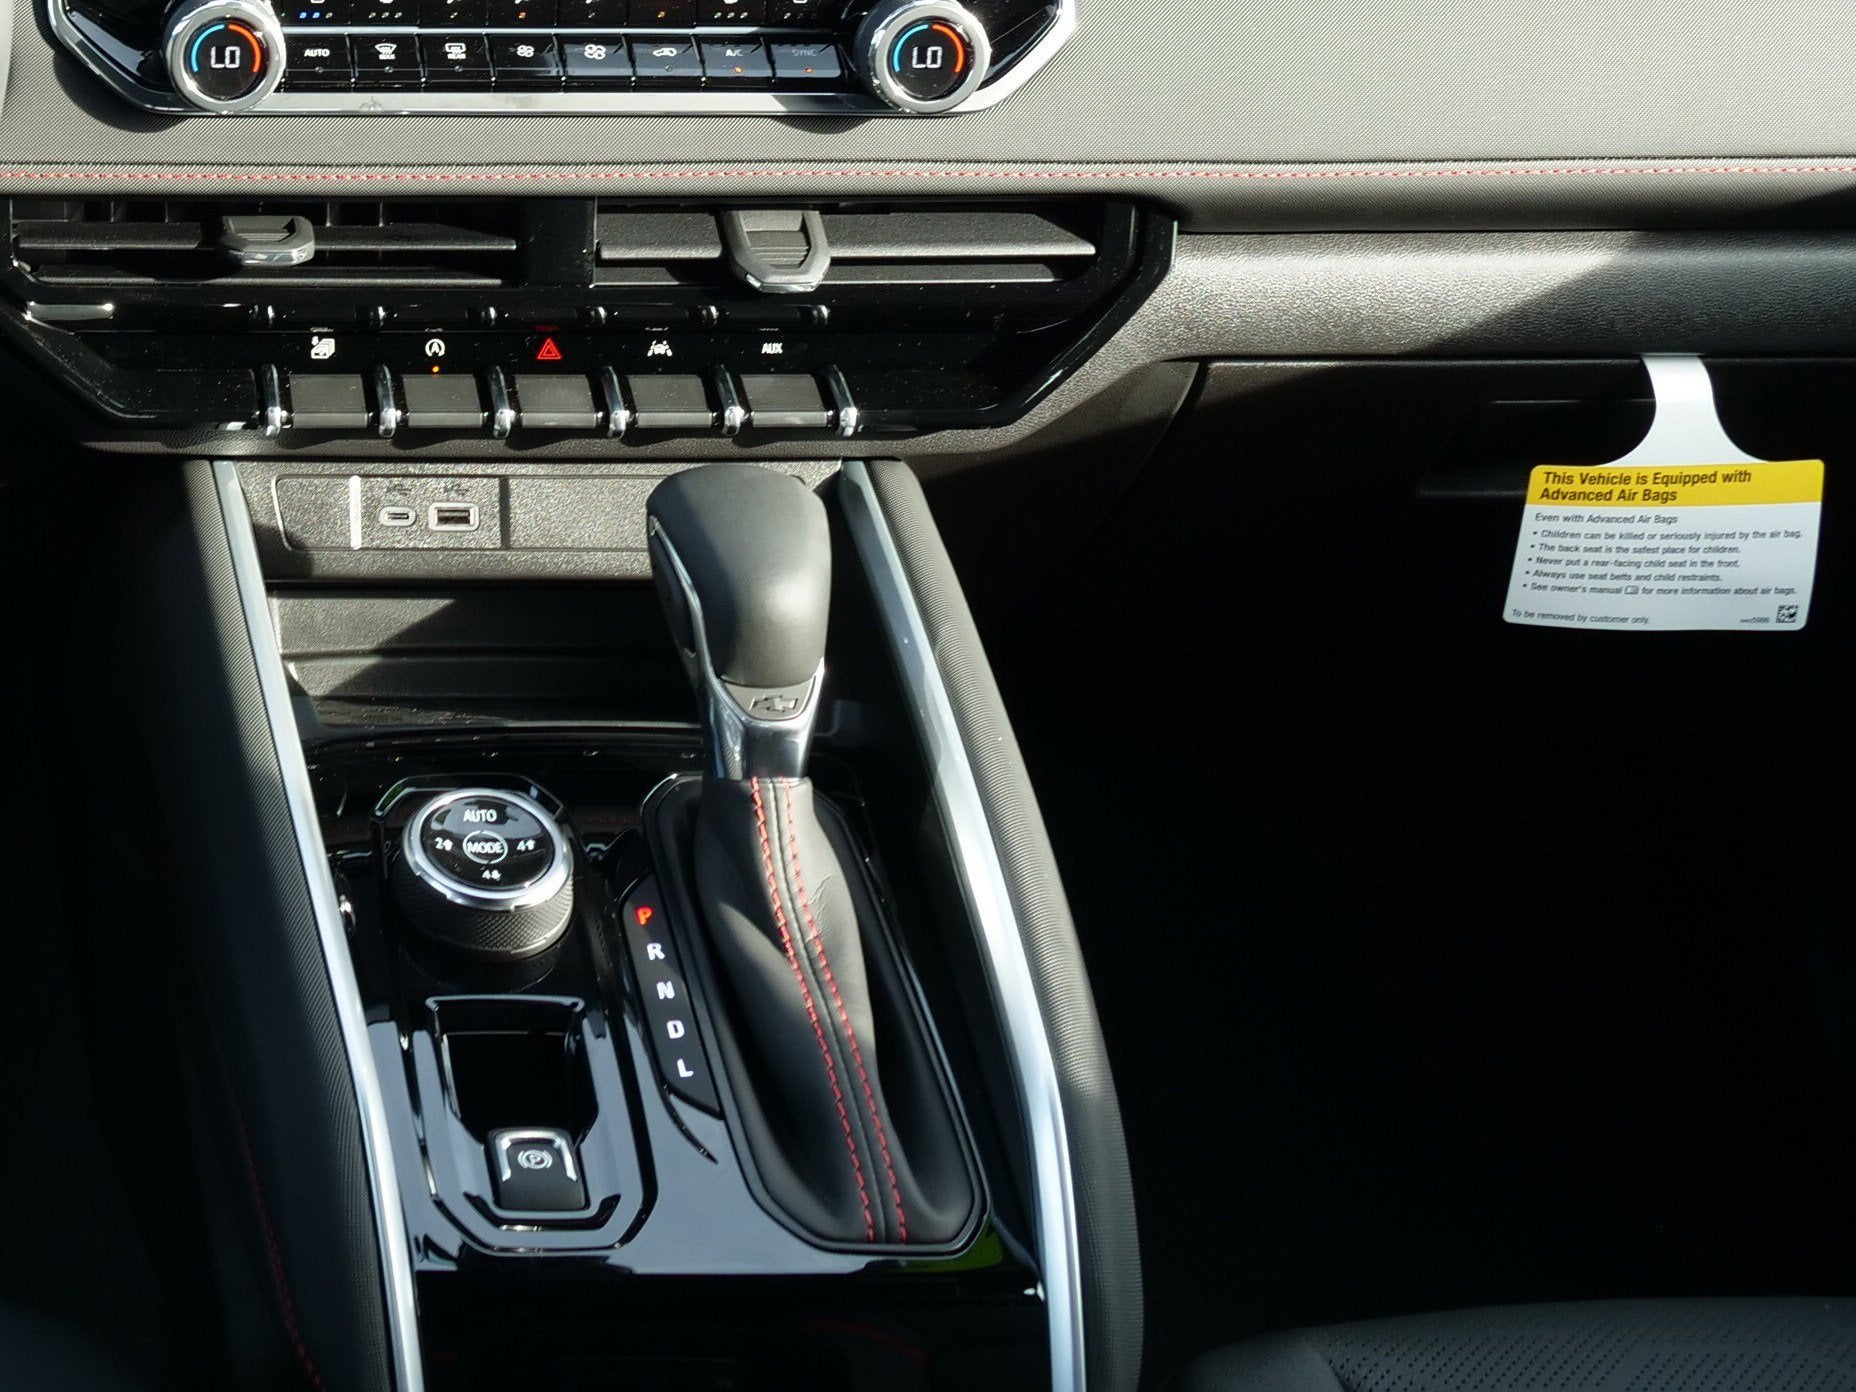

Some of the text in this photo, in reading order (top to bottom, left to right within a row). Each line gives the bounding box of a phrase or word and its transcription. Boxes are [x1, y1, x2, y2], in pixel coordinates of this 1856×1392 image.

[210, 45, 240, 69] LO
[304, 49, 330, 57] AUTO
[725, 49, 743, 57] A/C
[792, 49, 817, 57] SYNC
[911, 46, 942, 69] LO
[1543, 469, 1752, 488] This Vehicle is Equipped with
[1540, 488, 1678, 505] Advanced Air Bags
[1534, 512, 1678, 526] Even with Advanced Air Bags
[1540, 529, 1582, 539] Children
[1584, 531, 1601, 540] can
[1604, 531, 1616, 540] be
[1618, 531, 1645, 540] killed
[1647, 532, 1657, 540] or
[1659, 532, 1702, 542] seriously
[1704, 531, 1736, 541] injured
[1738, 531, 1750, 541] by
[1752, 530, 1766, 539] the
[1769, 530, 1781, 539] air
[1538, 542, 1741, 555] The back seat is the safest place for children.
[1535, 556, 1563, 566] Never
[1565, 558, 1582, 567] put
[1591, 558, 1642, 569] rear-facing
[1644, 559, 1666, 568] child
[1667, 559, 1687, 568] seat
[1689, 559, 1698, 568] in
[1700, 559, 1714, 568] the
[1716, 559, 1740, 568] front.
[1532, 569, 1722, 582] Always use seat belts and child restraints.
[1530, 582, 1548, 591] See
[1550, 584, 1587, 593] owner's
[1589, 585, 1623, 595] manual
[1641, 586, 1654, 595] for
[1656, 587, 1679, 595] more
[1680, 587, 1731, 595] information
[1732, 587, 1758, 595] about
[1759, 587, 1772, 595] air
[1511, 609, 1522, 618] To
[1523, 610, 1535, 619] be
[1537, 611, 1576, 621] removed
[1577, 613, 1588, 623] by
[1589, 614, 1629, 623] customer
[463, 809, 498, 823] AUTO
[466, 841, 504, 854] MODE
[636, 906, 653, 925] P
[646, 942, 665, 961] R
[656, 981, 675, 999] N
[666, 1019, 685, 1039] D
[676, 1059, 694, 1078] L
